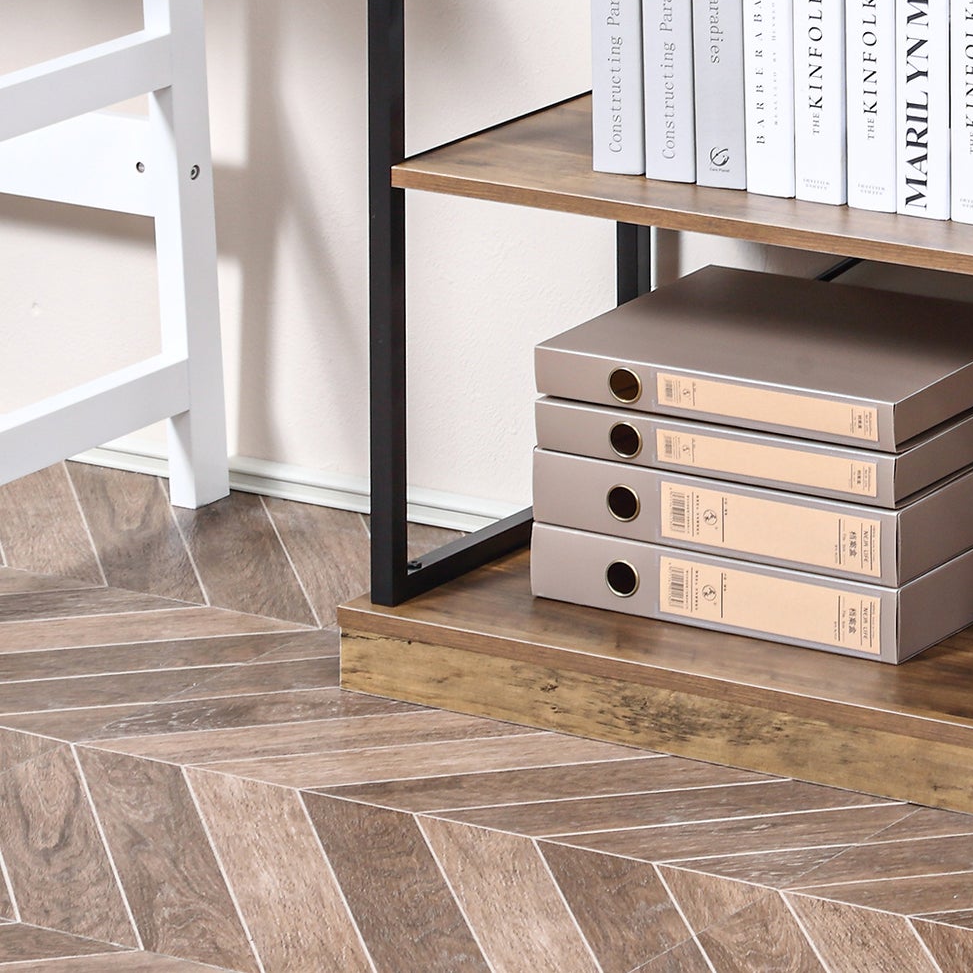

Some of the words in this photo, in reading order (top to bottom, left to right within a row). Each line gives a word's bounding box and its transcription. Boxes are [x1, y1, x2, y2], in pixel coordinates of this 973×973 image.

[607, 36, 623, 154] Constructing
[660, 41, 677, 160] Constructing
[812, 111, 821, 135] THE
[866, 116, 876, 140] THE
